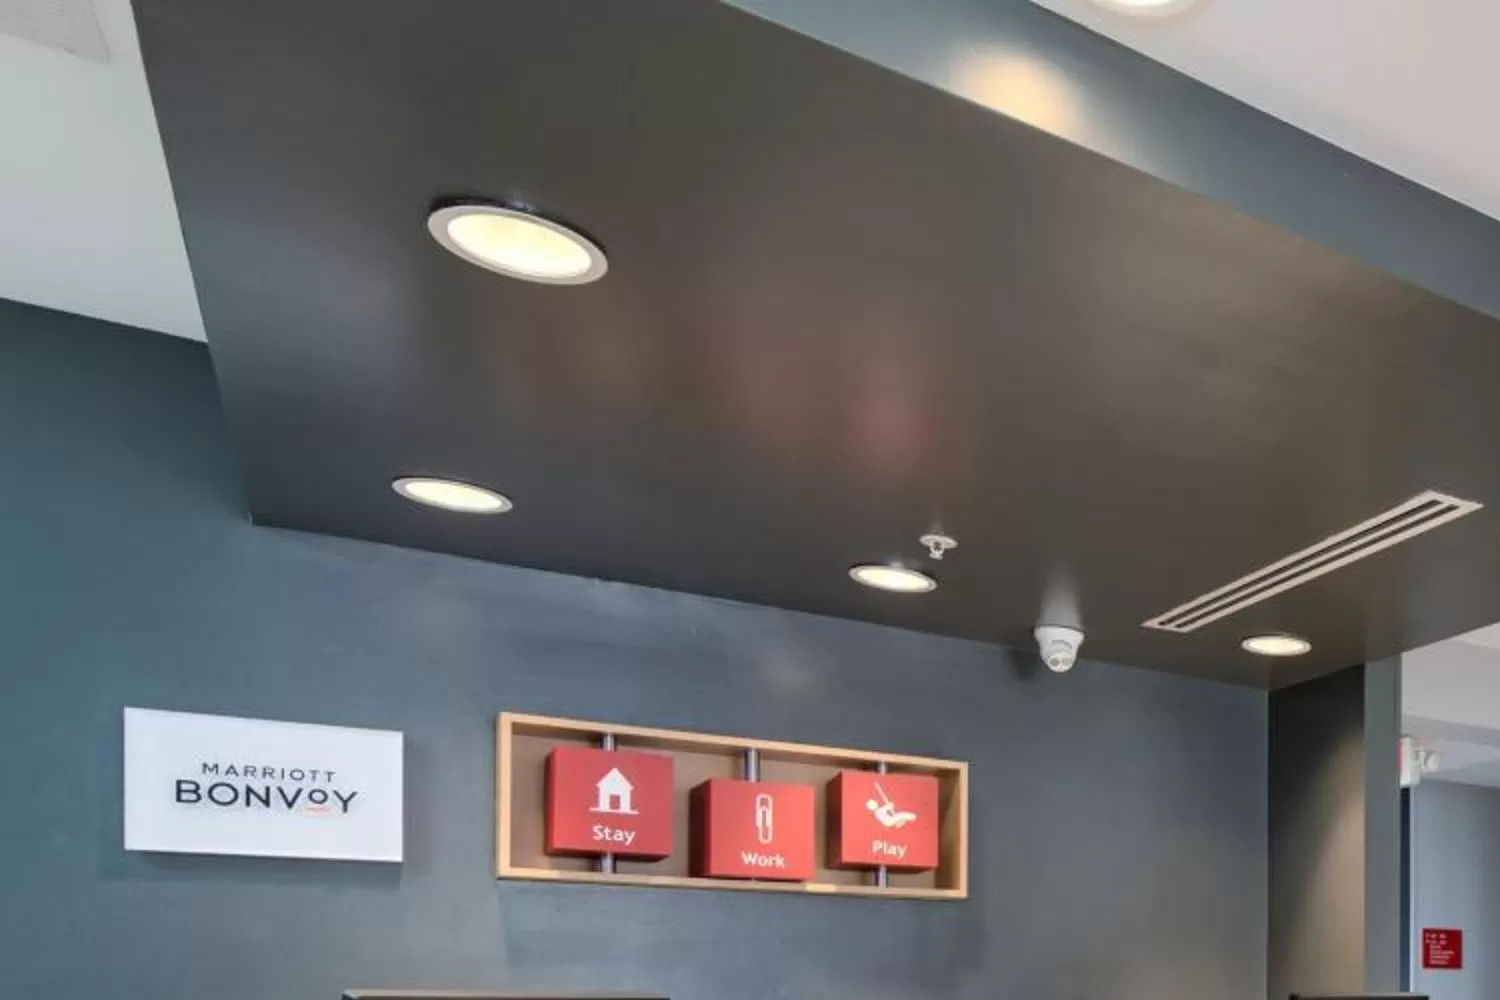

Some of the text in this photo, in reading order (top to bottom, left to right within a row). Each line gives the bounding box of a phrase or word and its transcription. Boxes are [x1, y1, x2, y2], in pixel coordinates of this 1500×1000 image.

[202, 762, 336, 783] MARRIOTT
[175, 779, 358, 813] BONVOY
[592, 825, 636, 845] Stay
[872, 839, 907, 857] Play
[741, 851, 786, 868] Work
